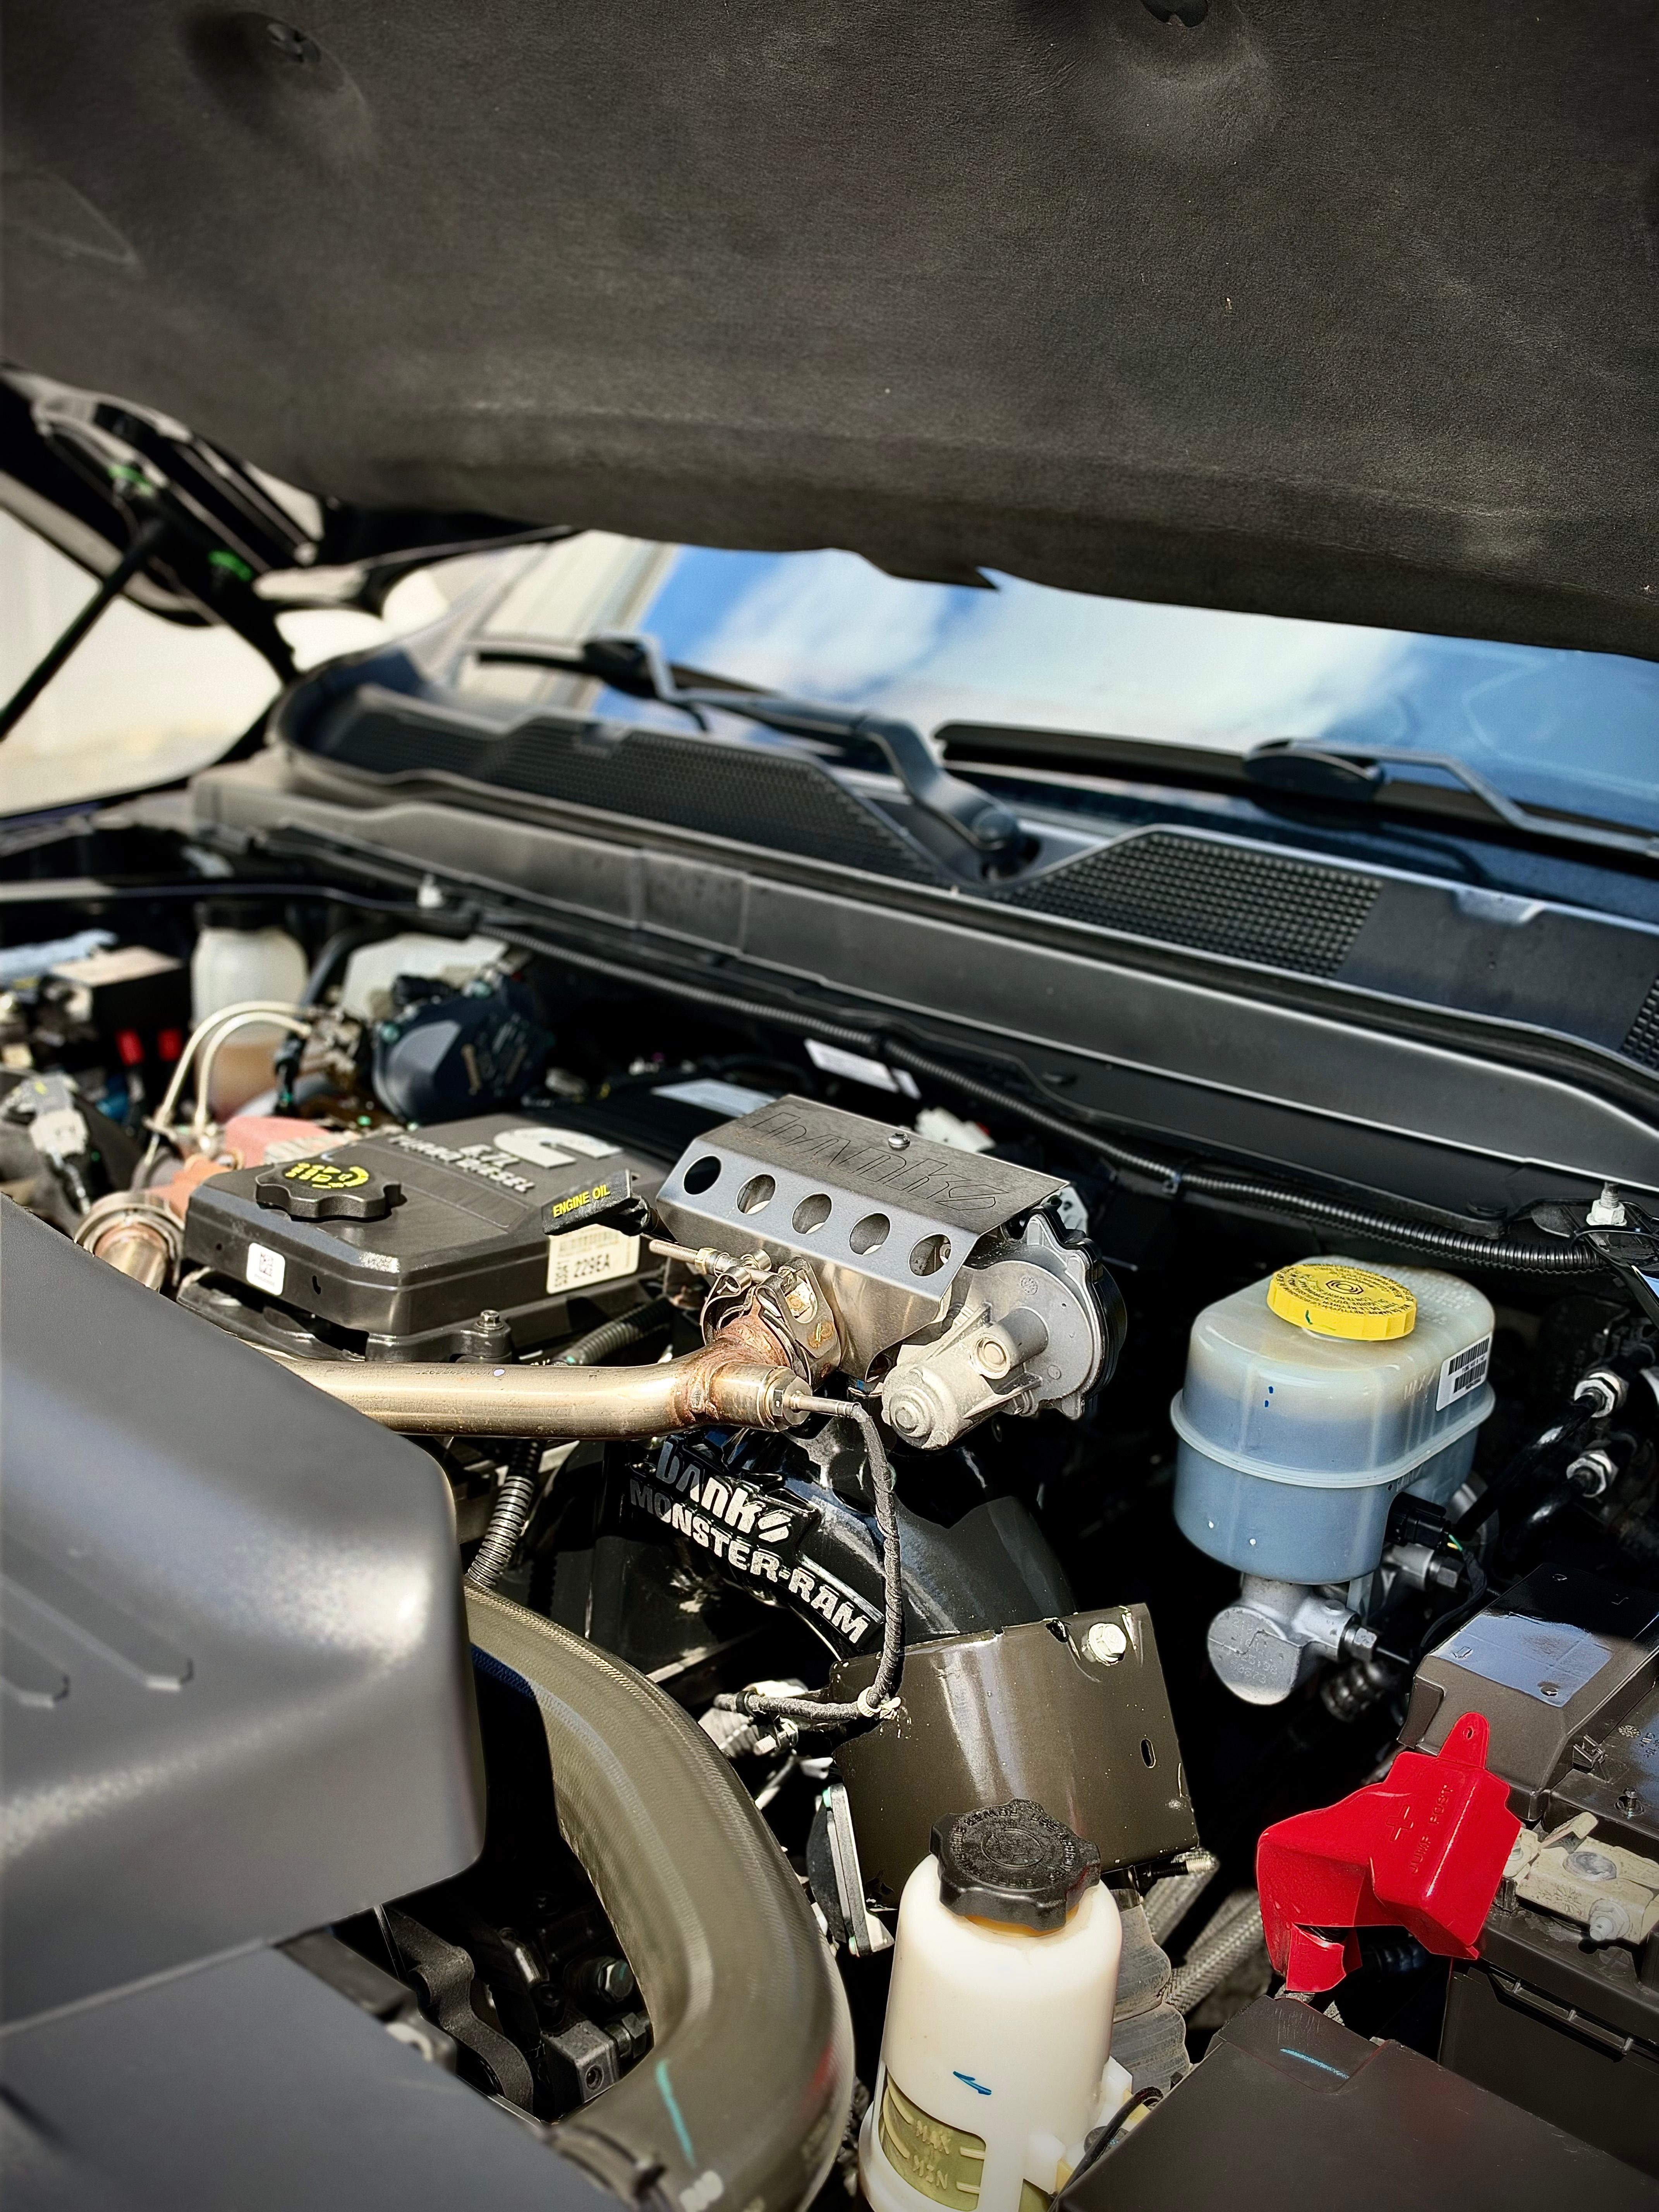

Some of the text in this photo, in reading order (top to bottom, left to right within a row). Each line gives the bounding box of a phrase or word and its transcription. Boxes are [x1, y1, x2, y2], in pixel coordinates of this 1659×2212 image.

[553, 1184, 610, 1218] ENGINE OIL
[630, 1479, 871, 1644] MONSTER-RAM
[963, 1809, 1020, 1827] POWER
[1409, 1784, 1453, 1874] JUMP POST
[915, 2120, 951, 2155] MAX
[912, 2154, 948, 2190] MIN
